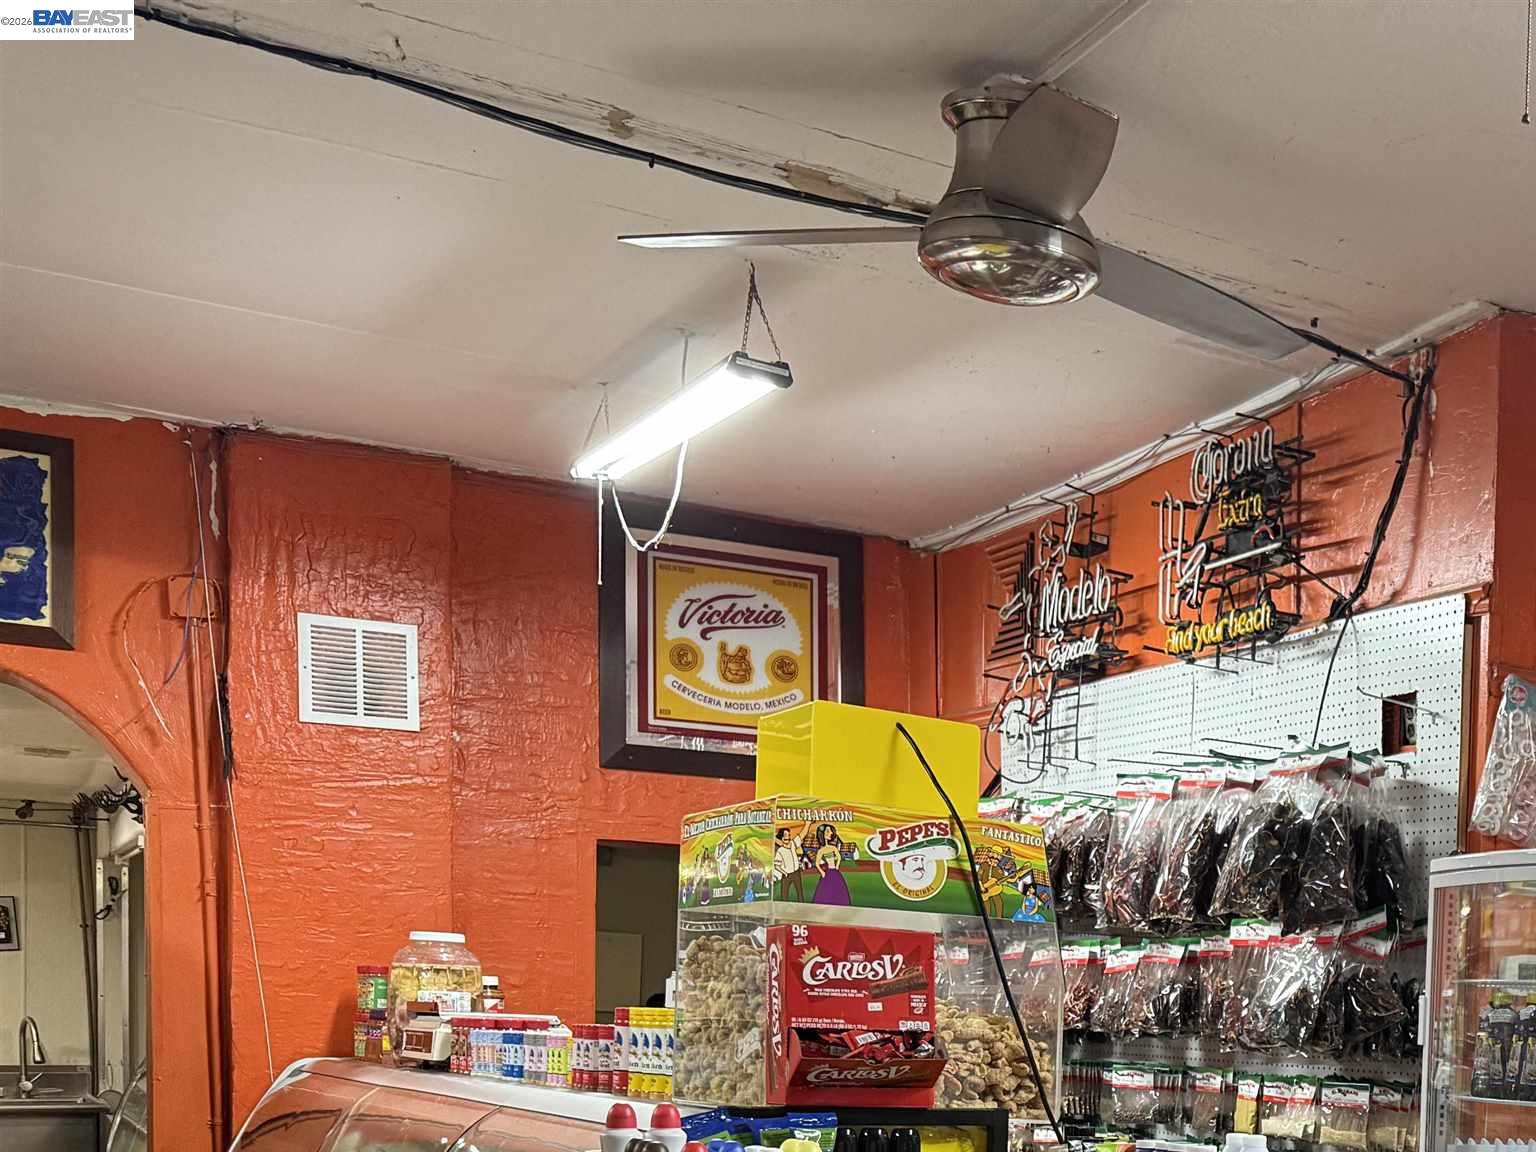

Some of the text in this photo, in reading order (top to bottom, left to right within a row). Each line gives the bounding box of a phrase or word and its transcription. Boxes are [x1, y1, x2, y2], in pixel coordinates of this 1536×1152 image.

[677, 594, 786, 640] Victoria
[1039, 563, 1112, 635] Modelo
[792, 924, 808, 937] 96
